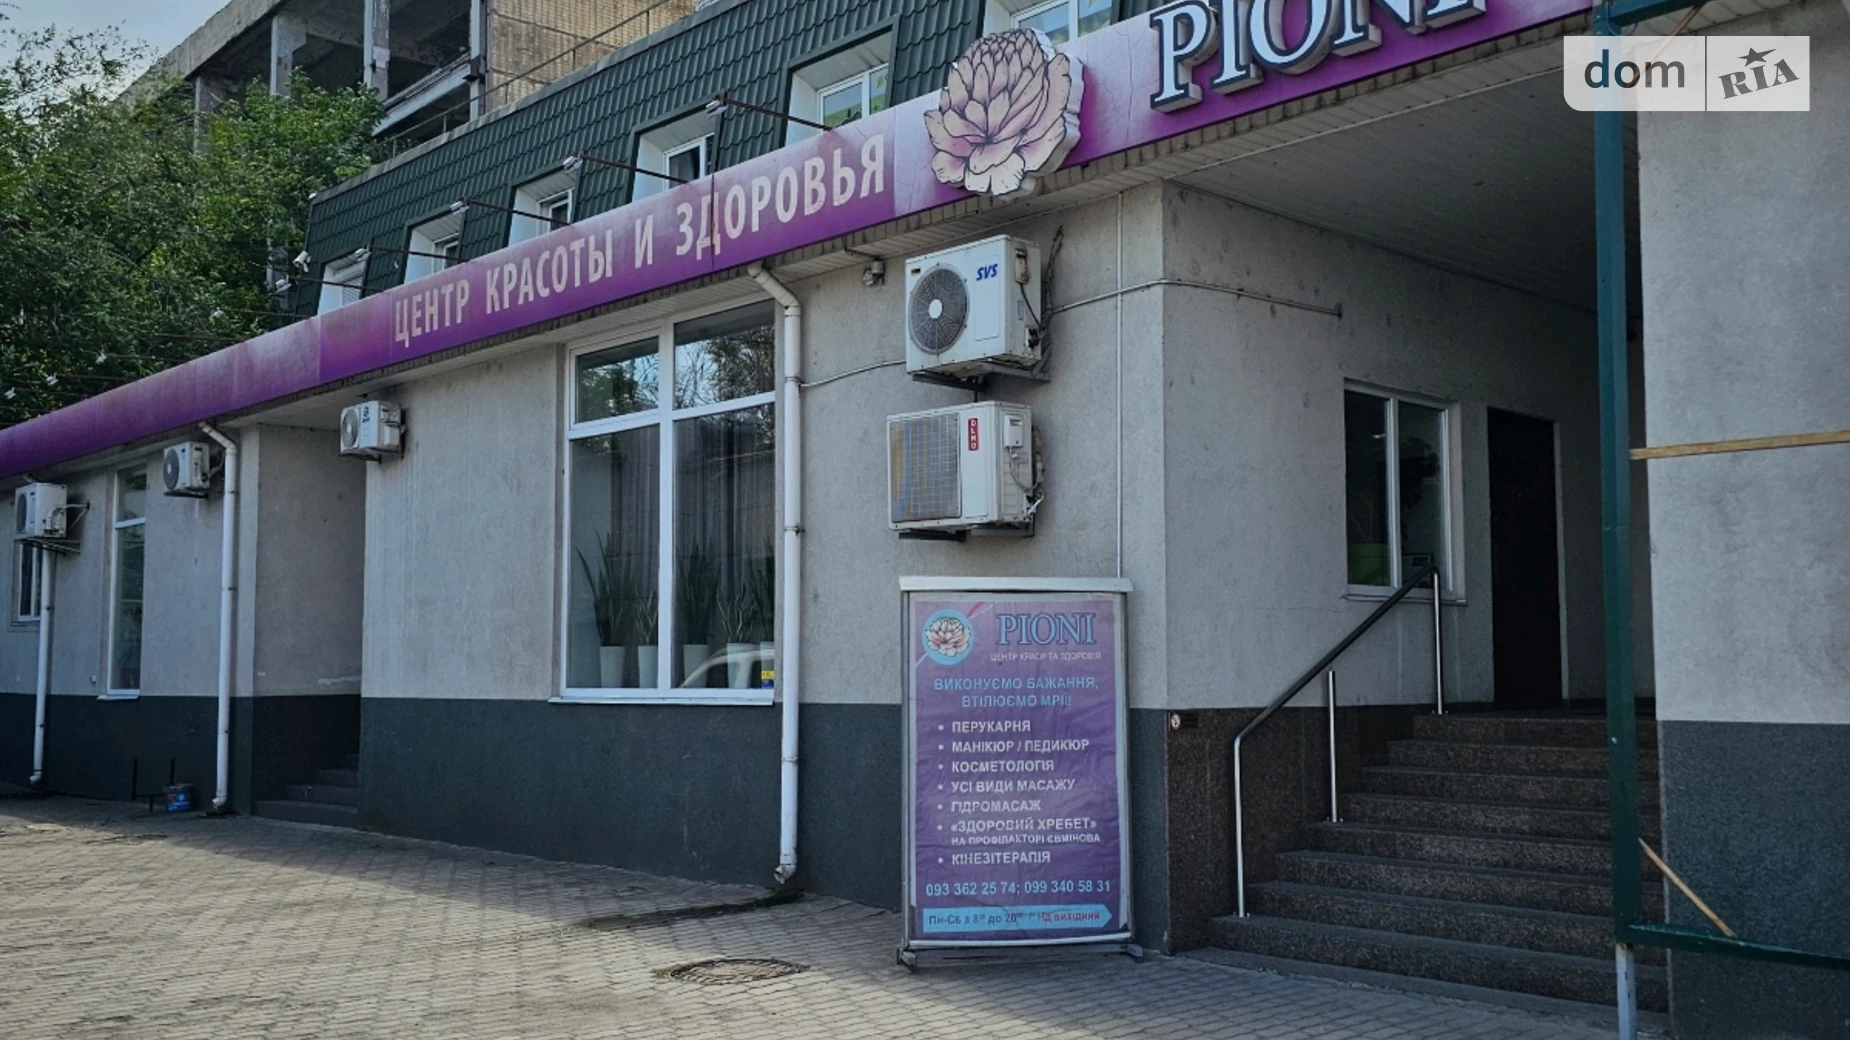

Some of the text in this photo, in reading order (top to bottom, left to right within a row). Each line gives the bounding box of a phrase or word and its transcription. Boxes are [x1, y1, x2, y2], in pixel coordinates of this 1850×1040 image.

[1150, 0, 1485, 112] PIO
[394, 134, 886, 347] ЦЕНТР КРАСОТЫ И ЗДОРОВЬЯ
[975, 263, 998, 281] SVS
[996, 612, 1097, 646] PIONI
[990, 652, 1018, 662] ЦЕНТР
[1020, 652, 1046, 661] КРАСИ
[1047, 652, 1059, 660] ТА
[933, 677, 1099, 691] ВИКОНУЄМО БАЖАННЯ,
[962, 695, 1037, 708] ВТІЛЮЄМО
[951, 719, 1031, 733] ПЕРУКАРНЯ
[951, 740, 1014, 753] МАНІКЮР
[1025, 739, 1090, 753] ПЕДИКЮР
[951, 760, 1054, 774] КОСМЕТОЛОГІЯ
[951, 779, 1075, 794] УСІ ВИДИ МАСАЖУ
[951, 800, 1041, 814] ГІДРОМАСАЖ
[951, 816, 1097, 834] «ЗДОРОВИЙ ХРЕБЕТ»
[951, 833, 1101, 847] НА ПРОФІЛАКТОРІ ЄВМІНОВА
[951, 851, 1051, 866] КІНЕЗІТЕРАПІЯ
[925, 879, 1111, 897] 093 362 25 74; 099 340 58 31
[988, 915, 1001, 925] до
[1054, 911, 1100, 922] вихідний
